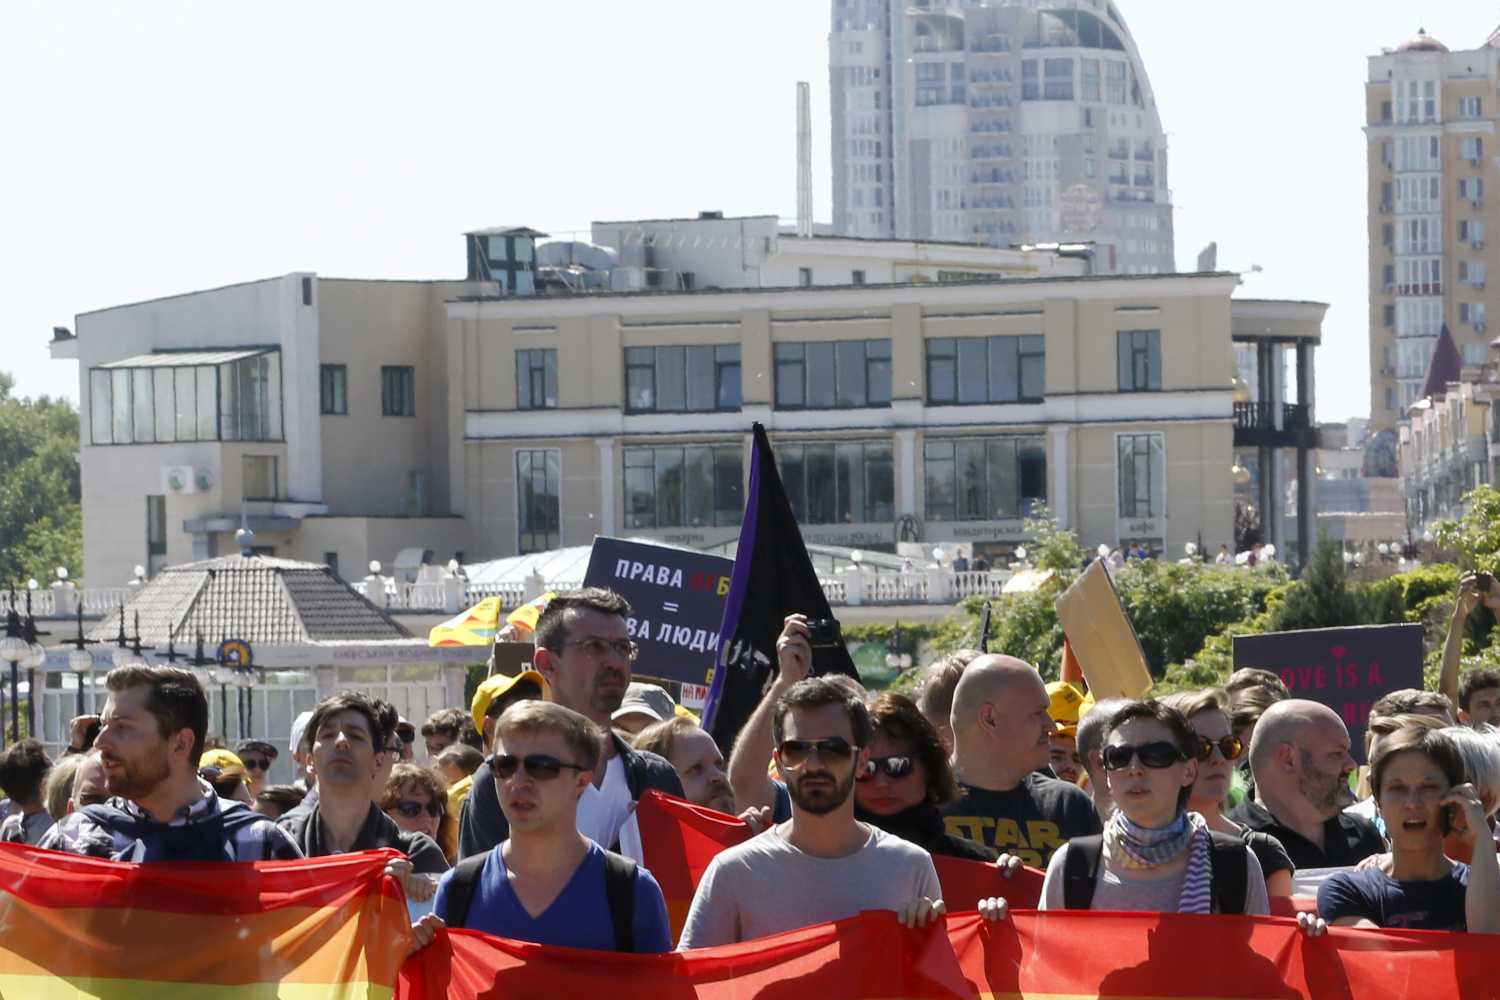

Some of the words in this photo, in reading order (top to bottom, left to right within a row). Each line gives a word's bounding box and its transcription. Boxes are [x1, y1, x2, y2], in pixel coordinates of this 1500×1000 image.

[615, 558, 683, 588] ПРАВА
[656, 623, 720, 653] ЛЮДИ
[1281, 665, 1326, 690] OVE
[1367, 661, 1384, 687] A
